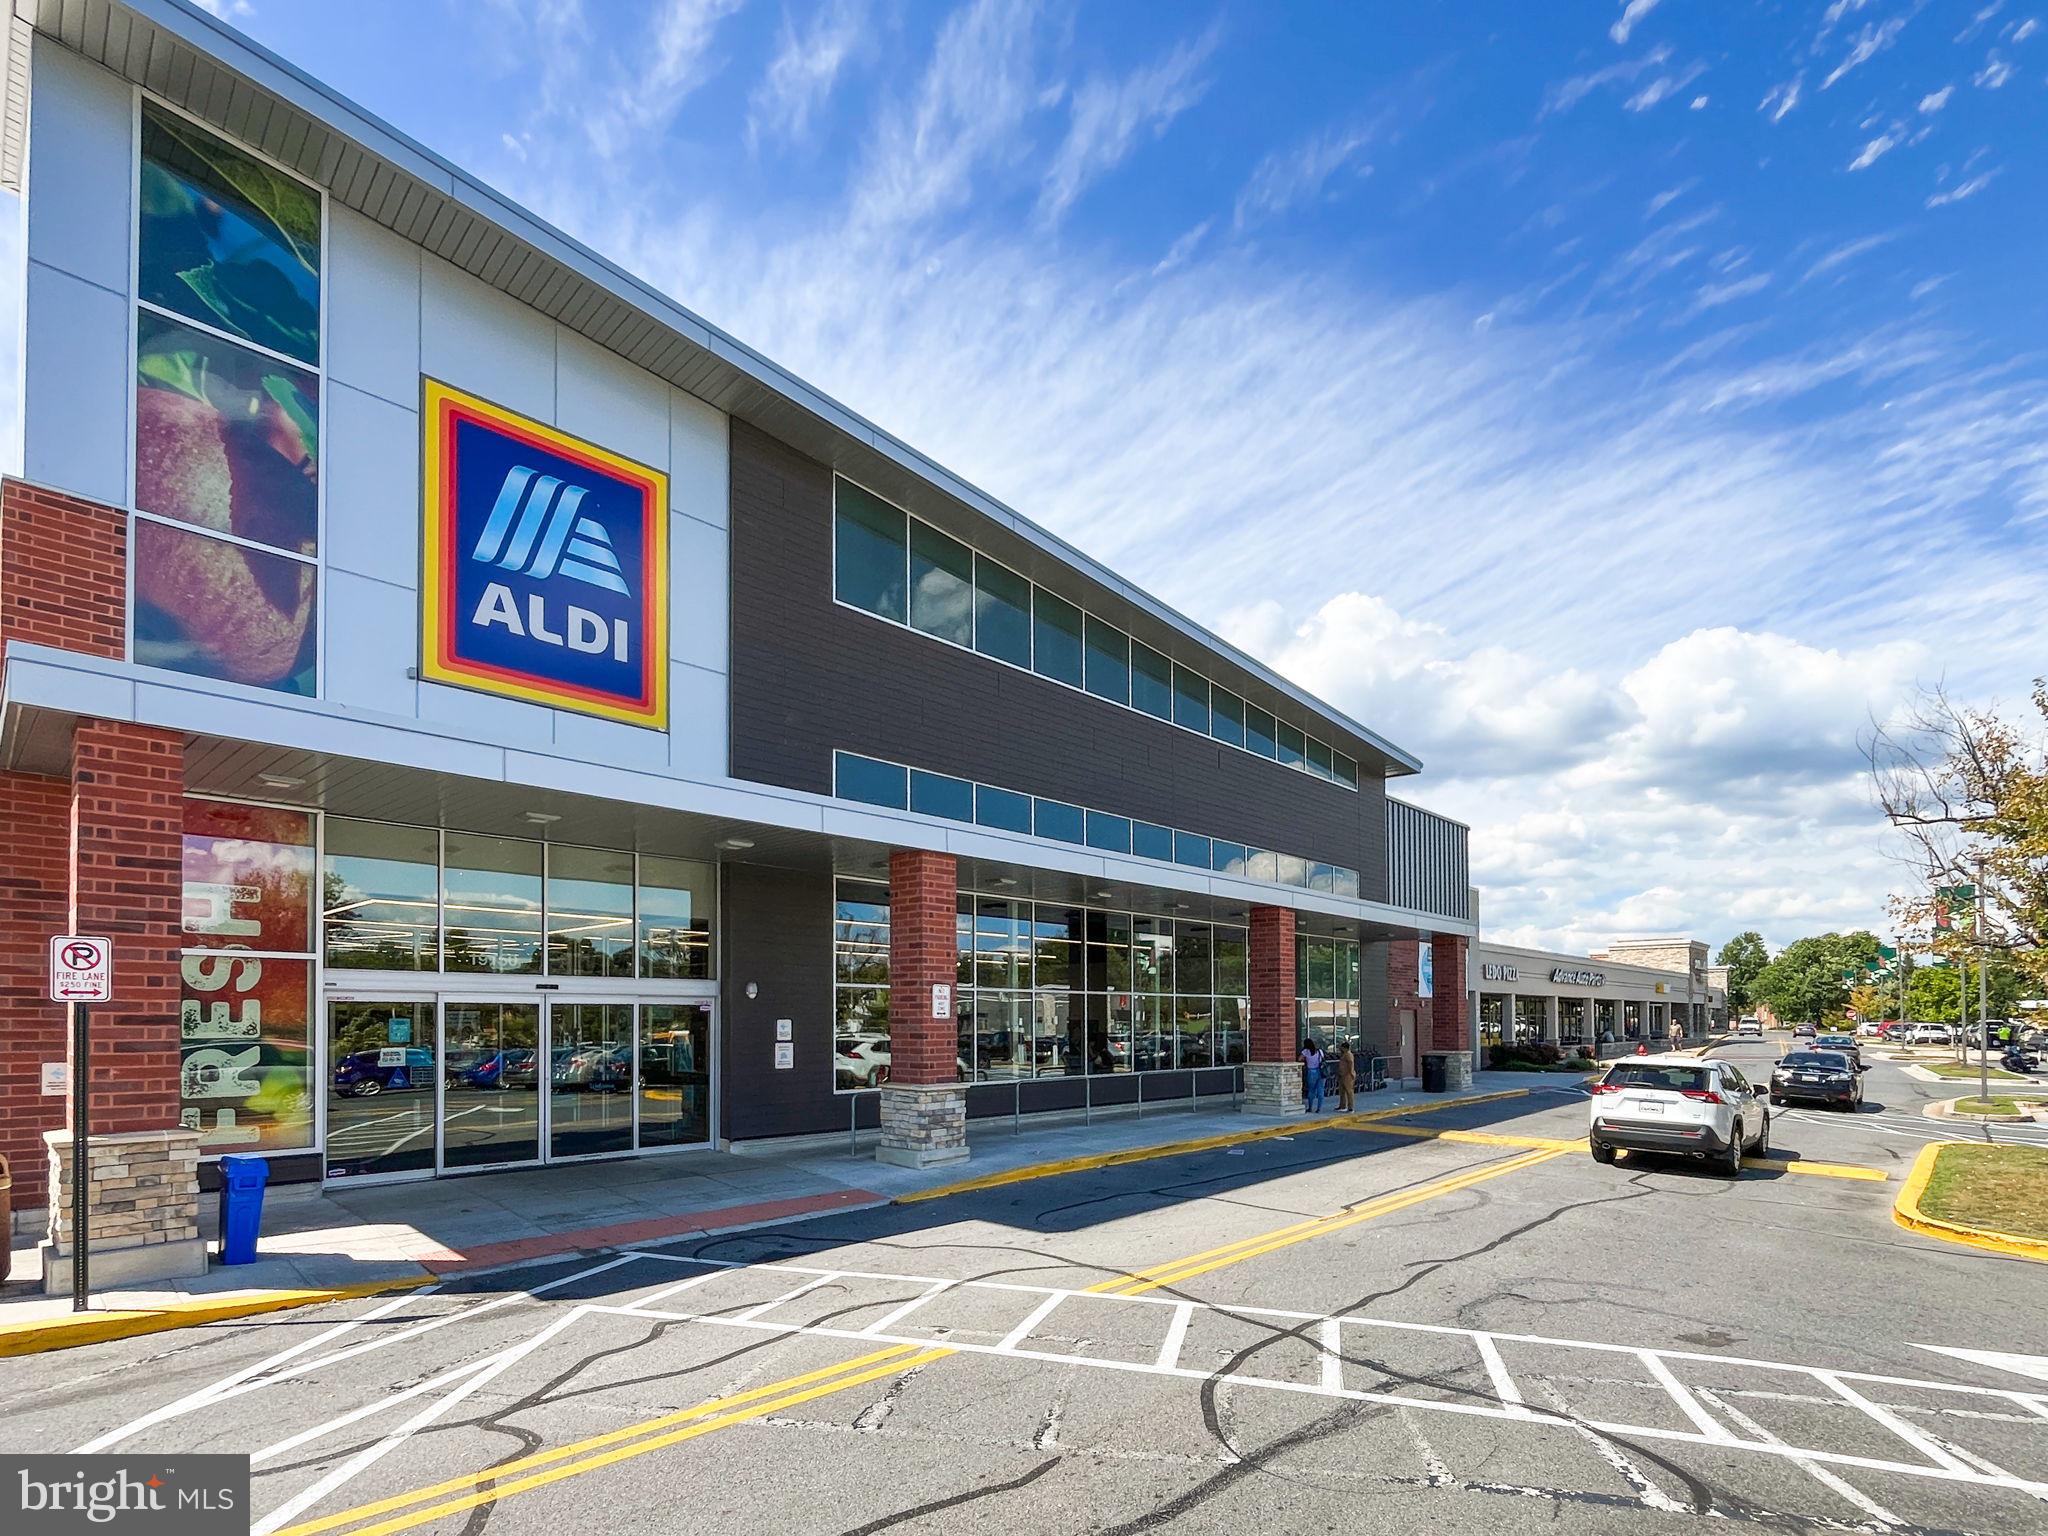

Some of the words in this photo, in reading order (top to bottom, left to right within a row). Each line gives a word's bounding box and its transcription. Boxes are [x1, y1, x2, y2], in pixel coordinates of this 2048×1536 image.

[472, 582, 628, 662] ALDI
[57, 972, 78, 980] FIRE
[82, 973, 105, 981] LANE
[1484, 964, 1502, 980] LEDO
[181, 881, 262, 1145] FRESH
